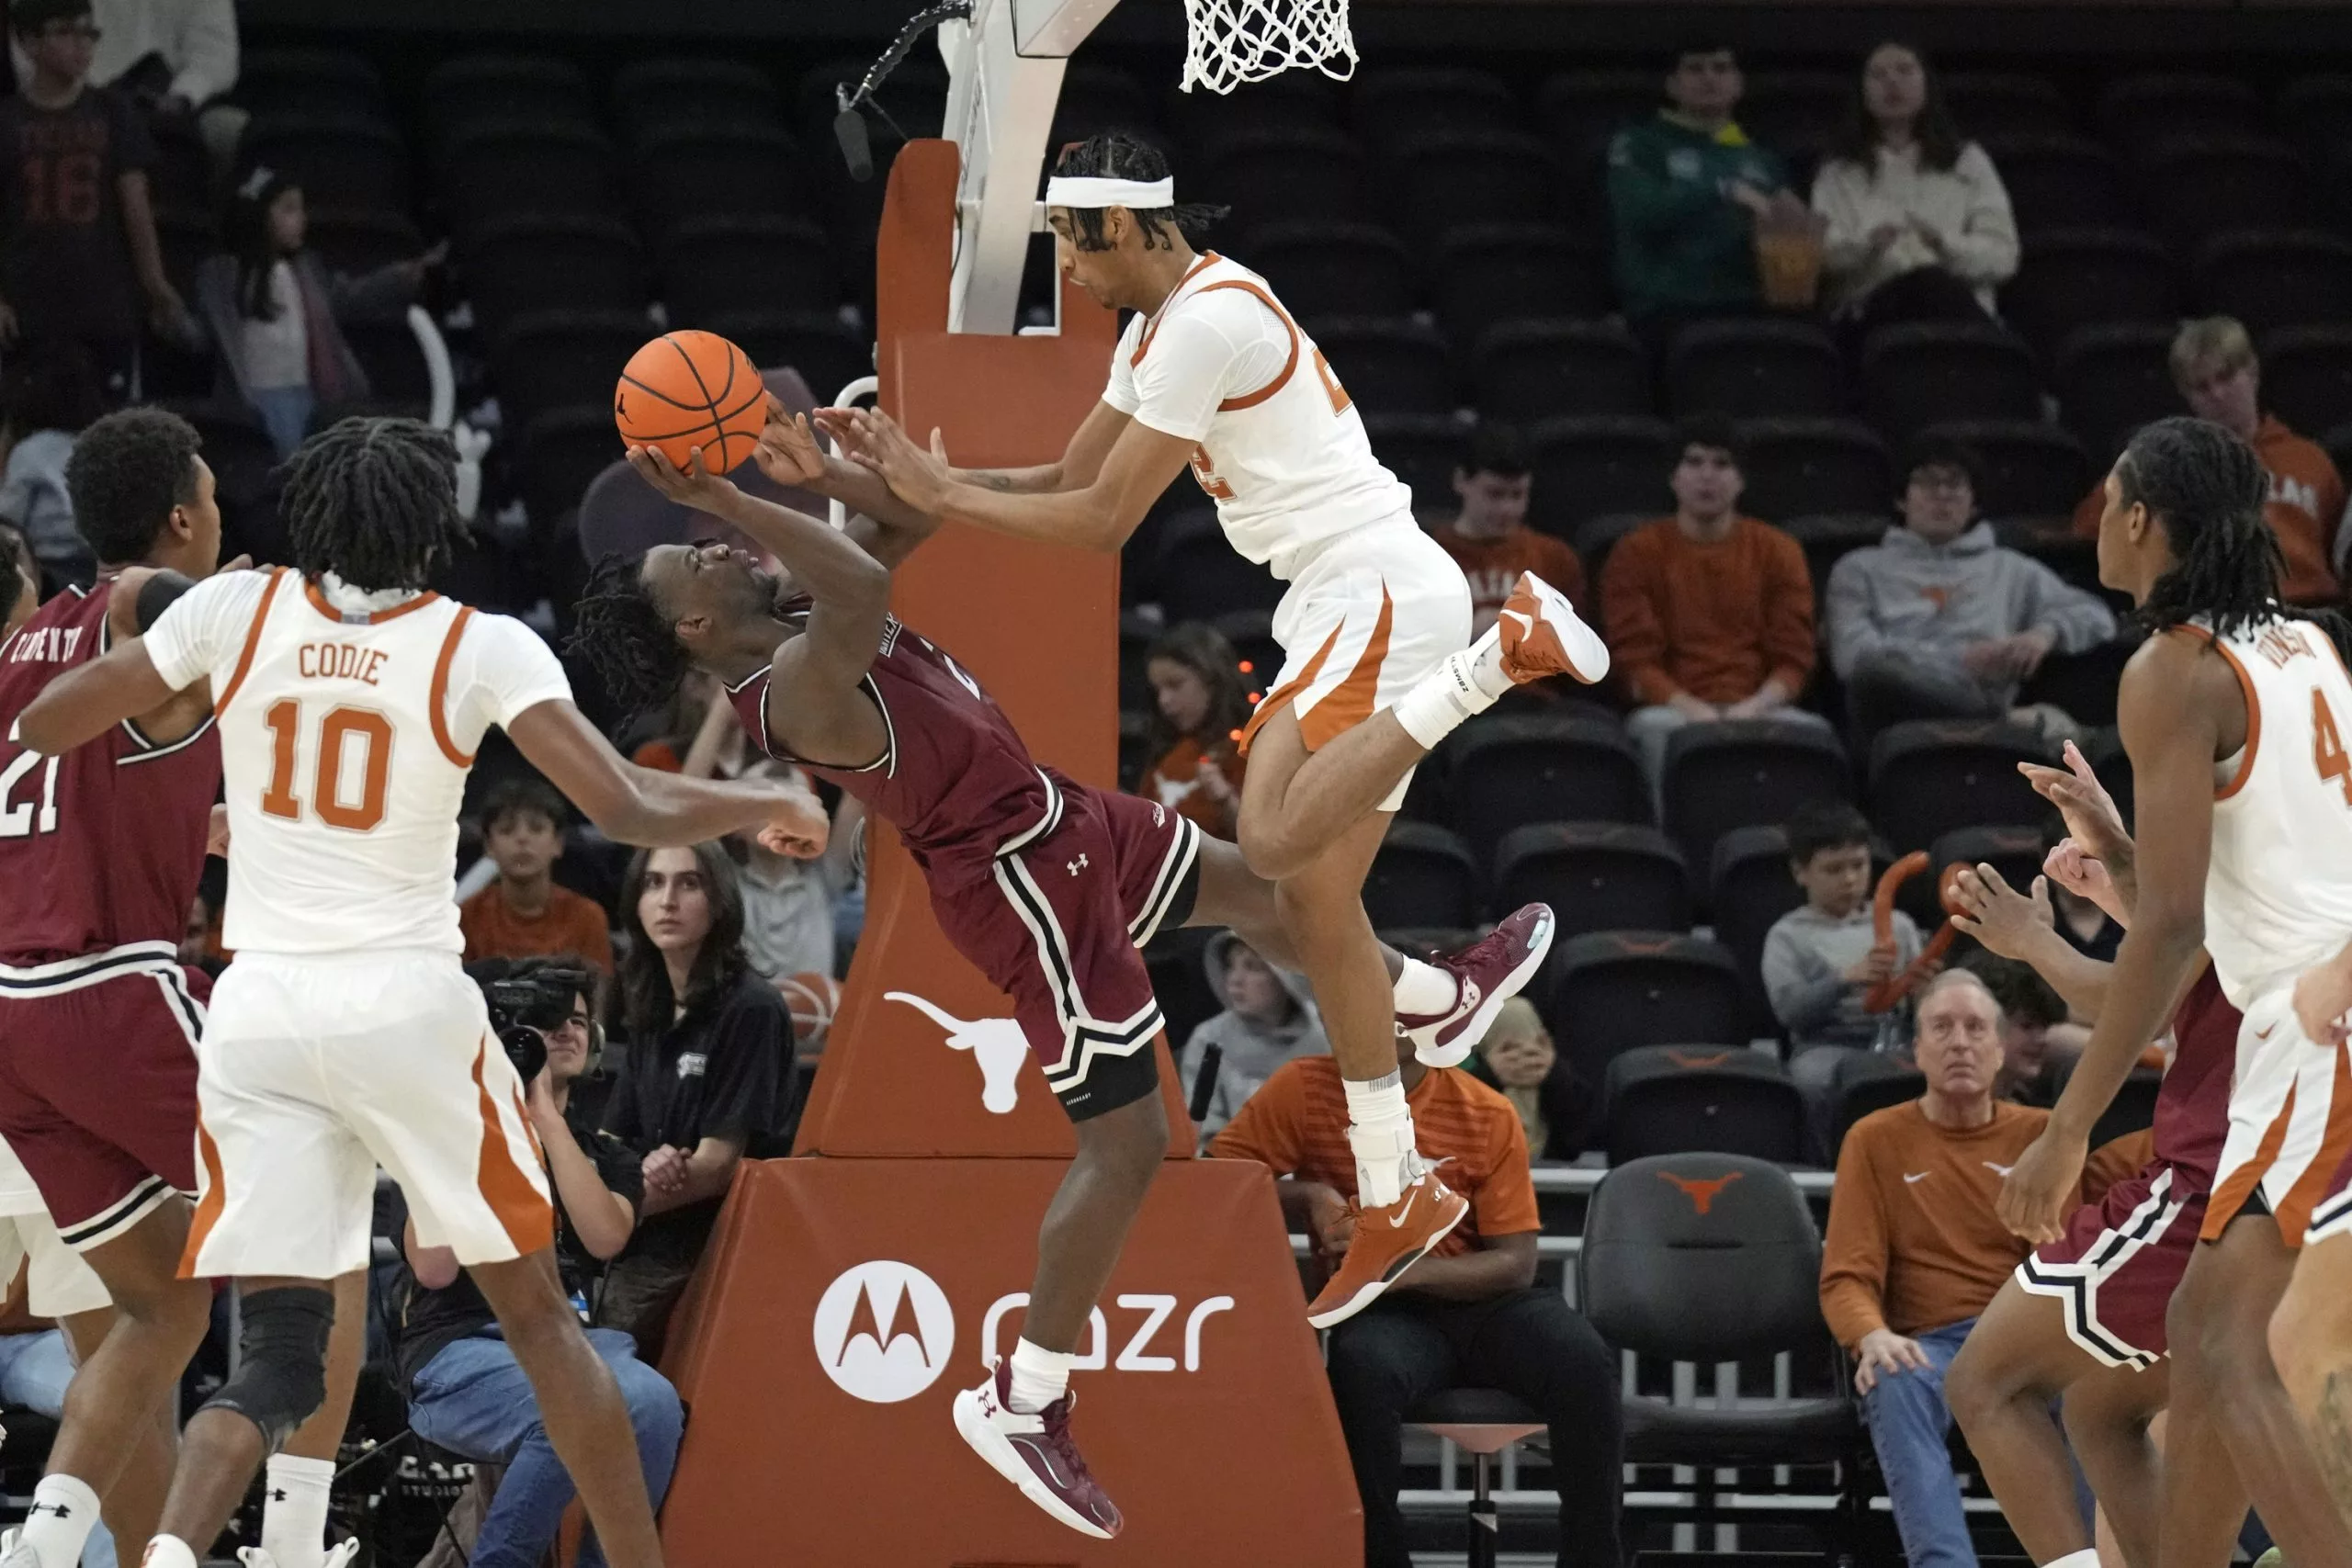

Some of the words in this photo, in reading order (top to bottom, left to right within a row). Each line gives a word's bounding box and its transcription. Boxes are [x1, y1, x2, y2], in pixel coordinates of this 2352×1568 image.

[299, 642, 390, 687] CODIE
[0, 716, 61, 838] 21
[260, 695, 398, 835] 10
[2310, 684, 2352, 810] 4
